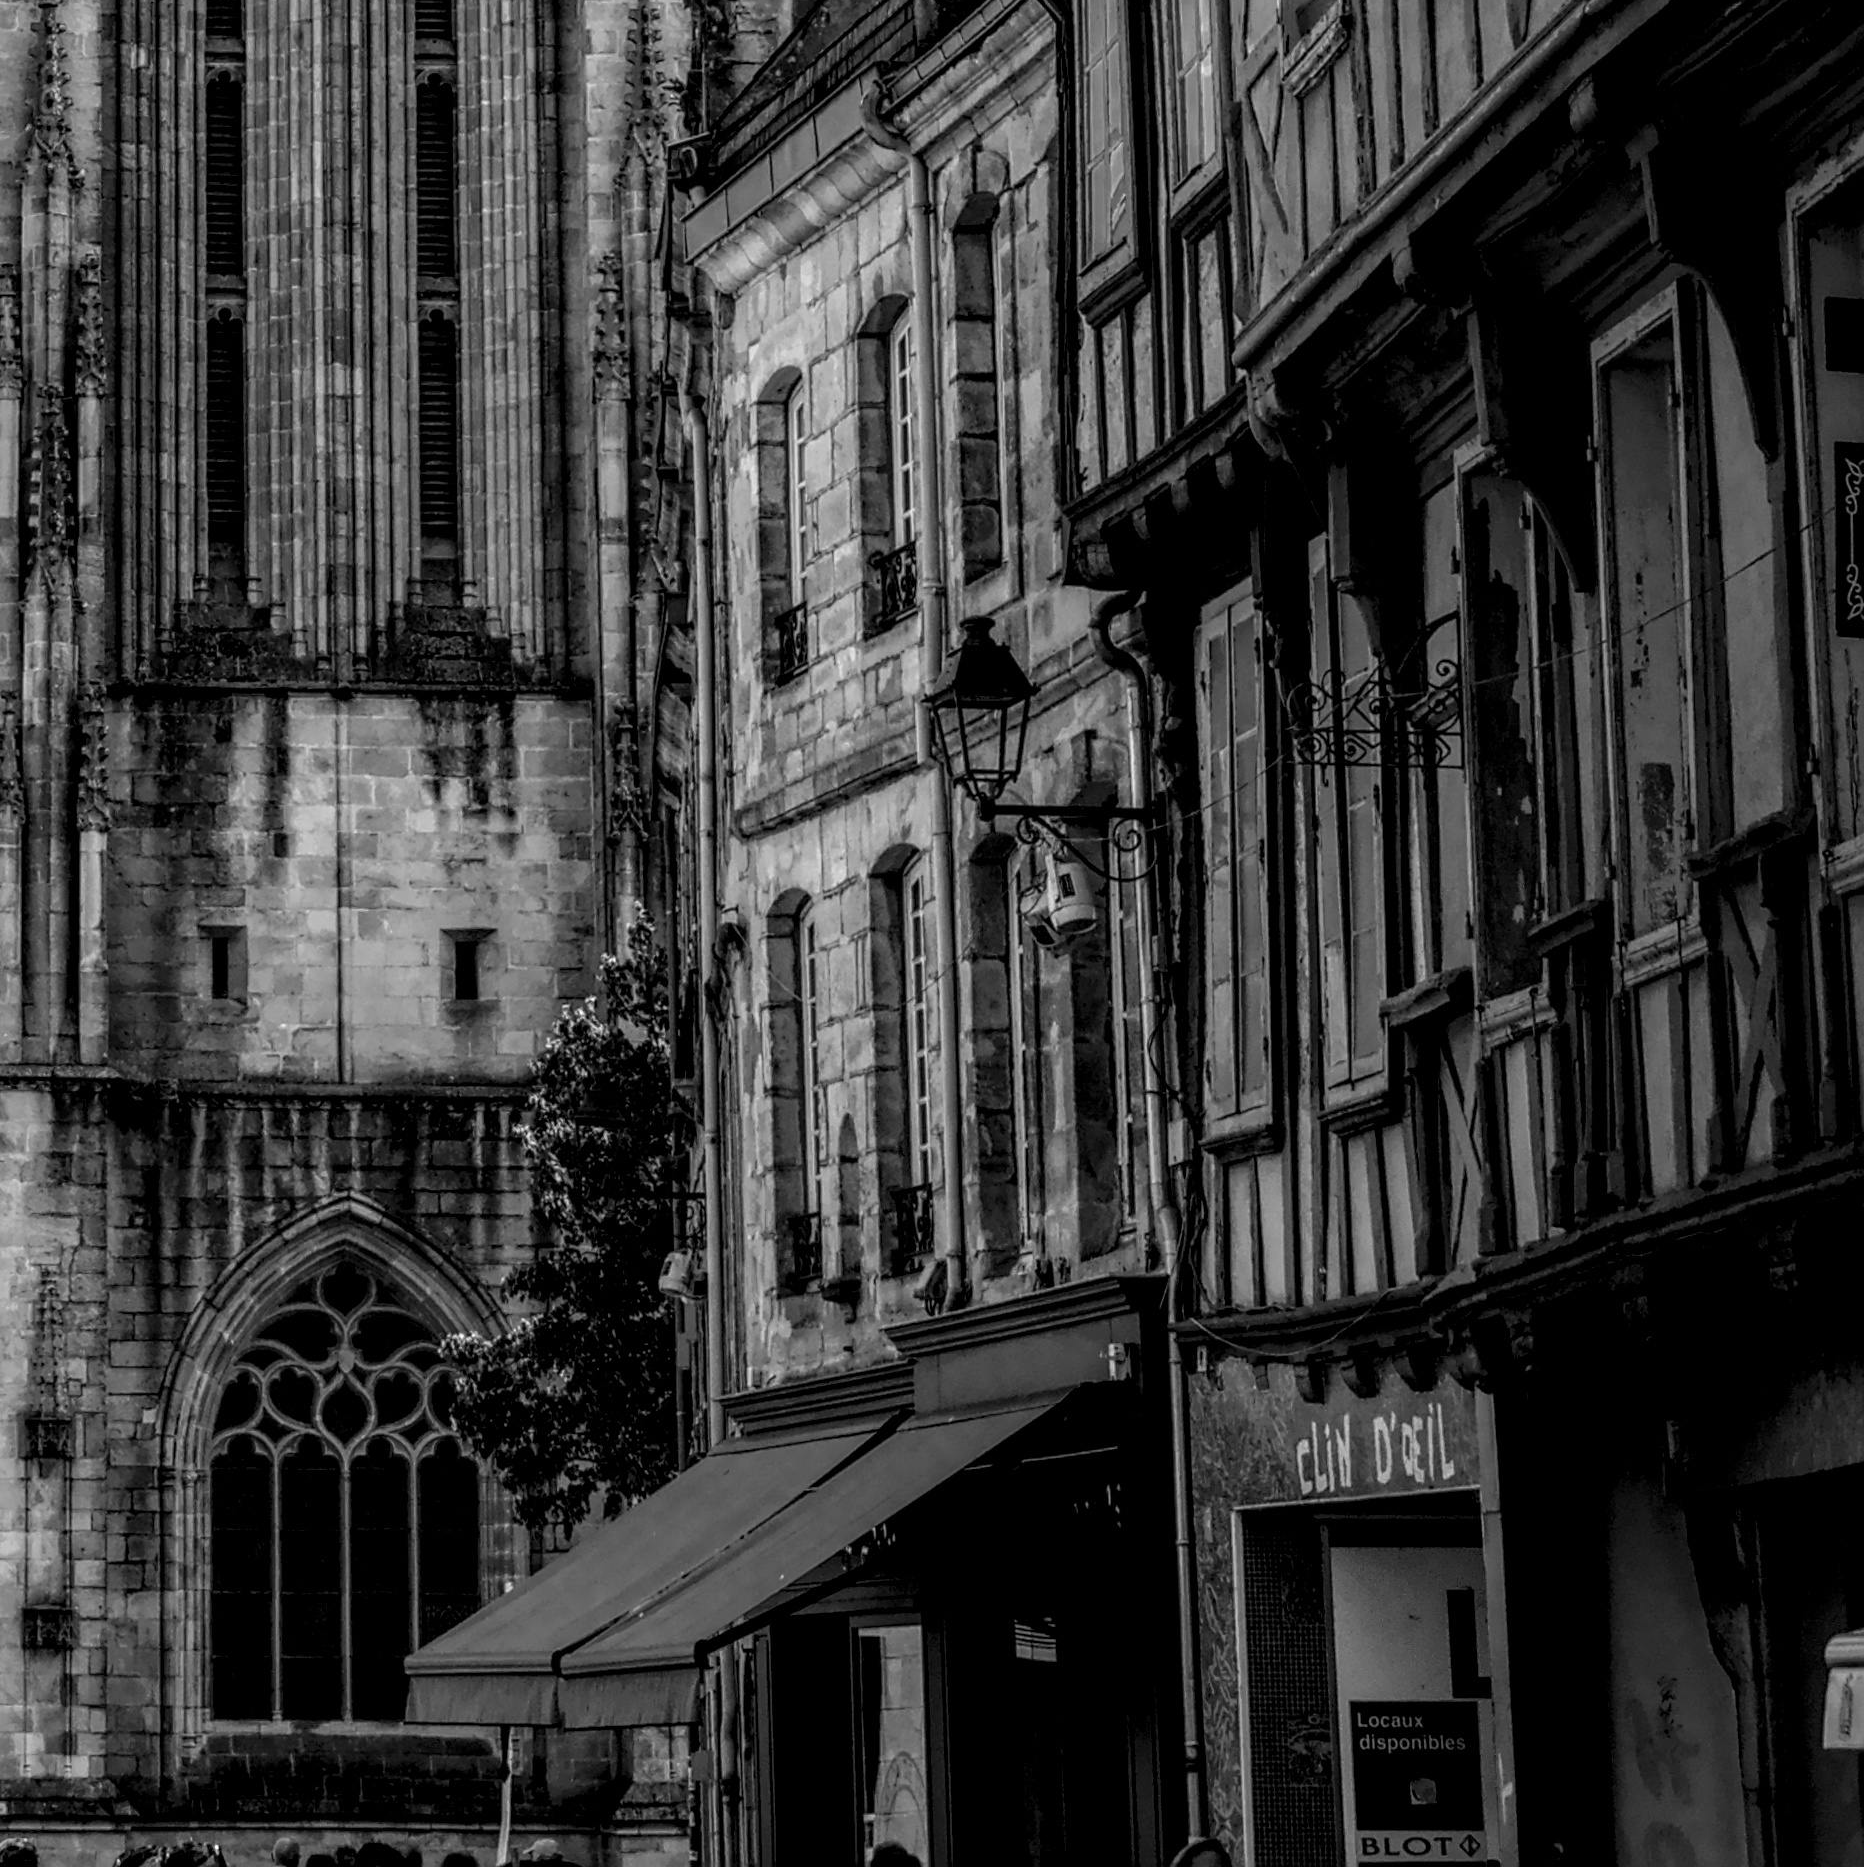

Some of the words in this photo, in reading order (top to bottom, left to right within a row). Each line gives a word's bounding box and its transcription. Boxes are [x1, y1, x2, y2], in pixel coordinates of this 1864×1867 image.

[1357, 1712, 1424, 1728] Locaux
[1359, 1734, 1466, 1754] disponibles
[1361, 1837, 1452, 1856] BLOT
